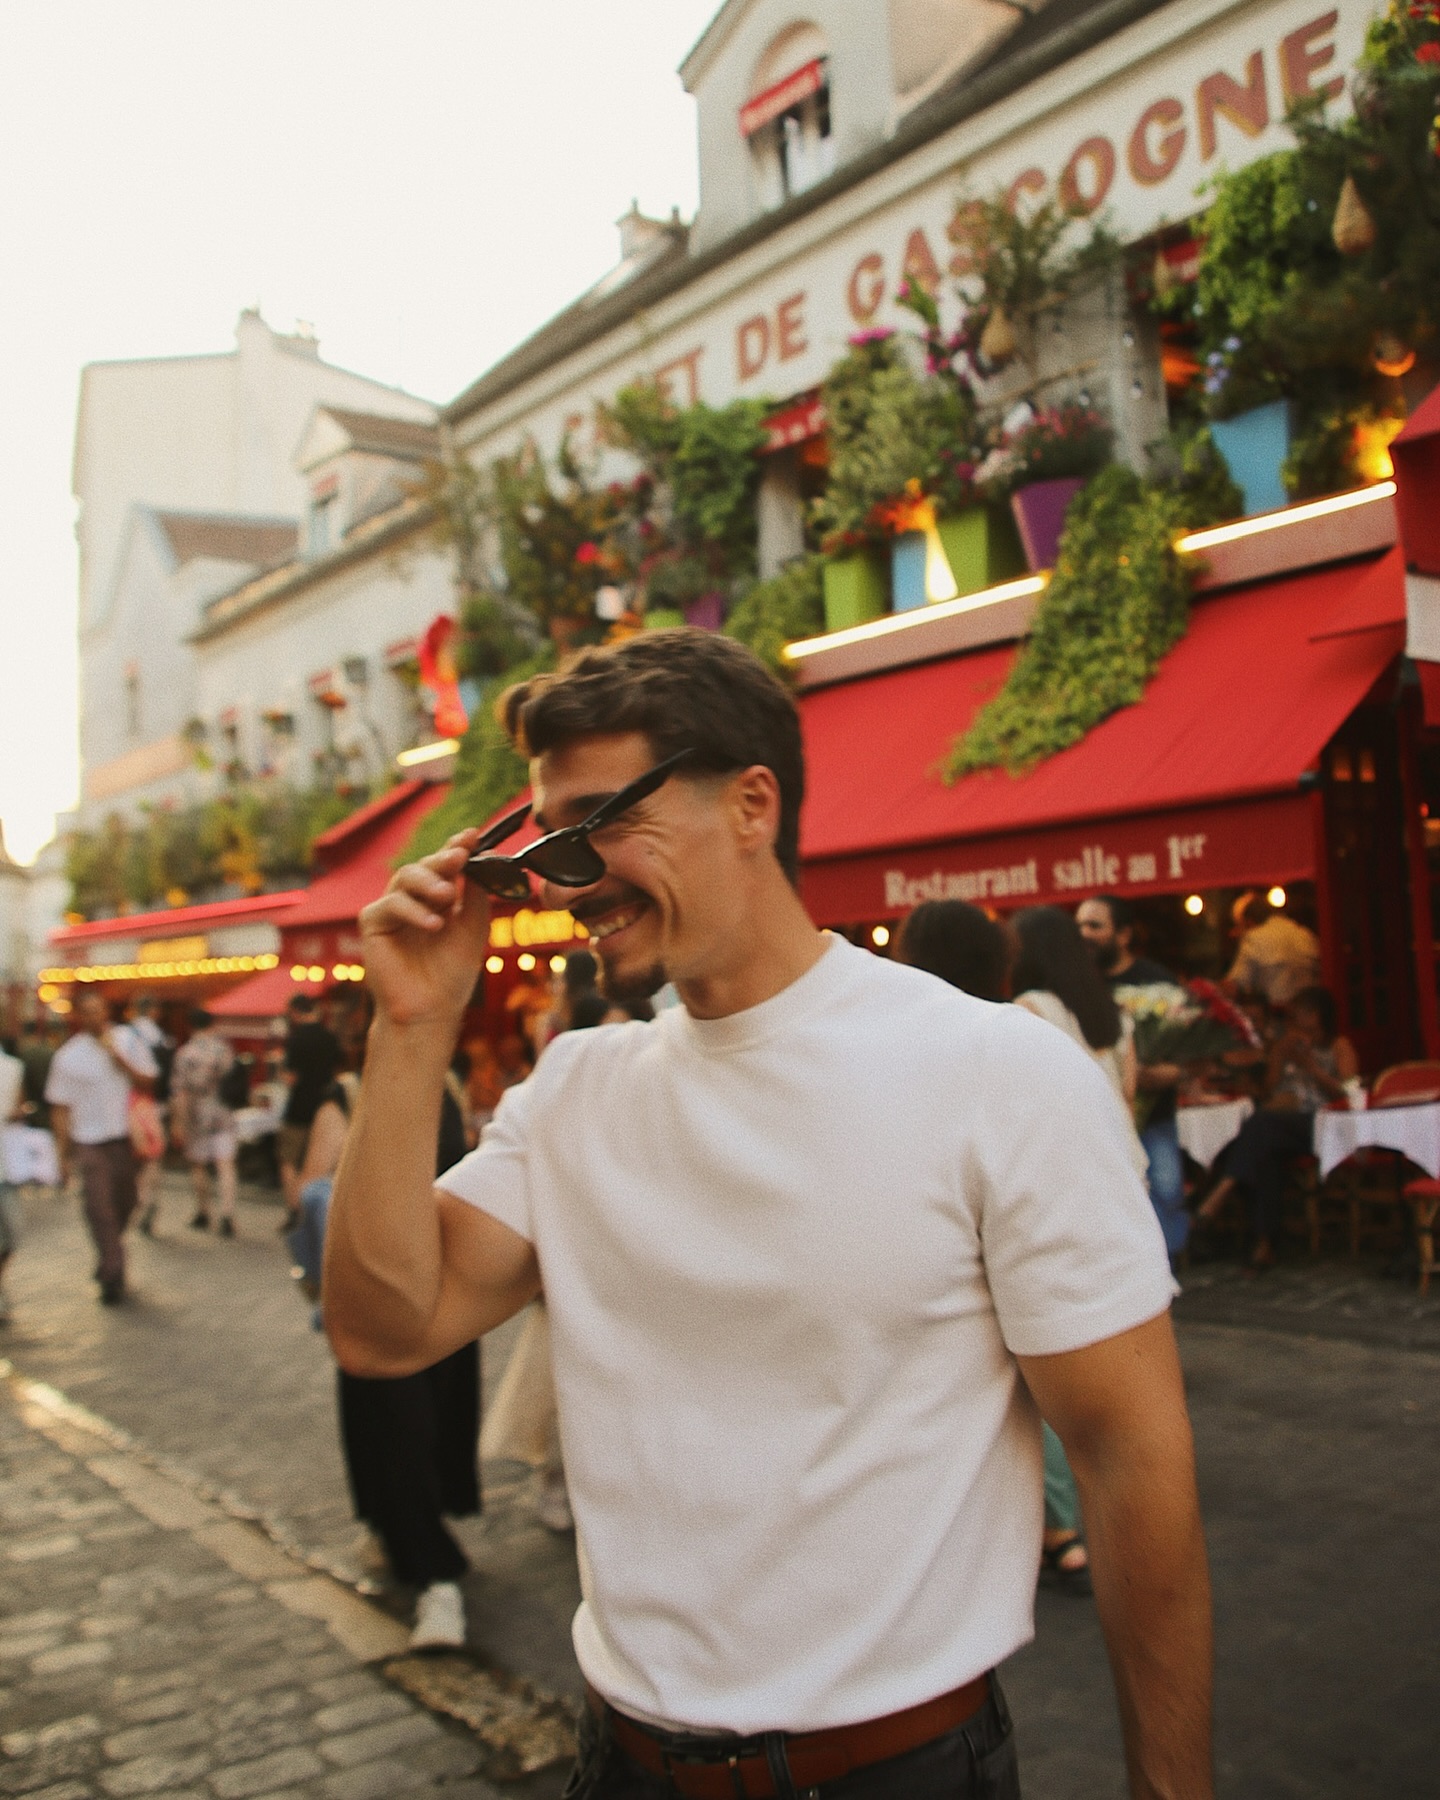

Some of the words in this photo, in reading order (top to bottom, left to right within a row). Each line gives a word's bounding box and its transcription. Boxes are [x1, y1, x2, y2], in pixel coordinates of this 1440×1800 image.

[735, 290, 809, 383] DE
[884, 858, 1039, 908] Restaurant
[1053, 845, 1121, 890] salle
[1127, 854, 1157, 883] au
[1167, 833, 1207, 879] 1er
